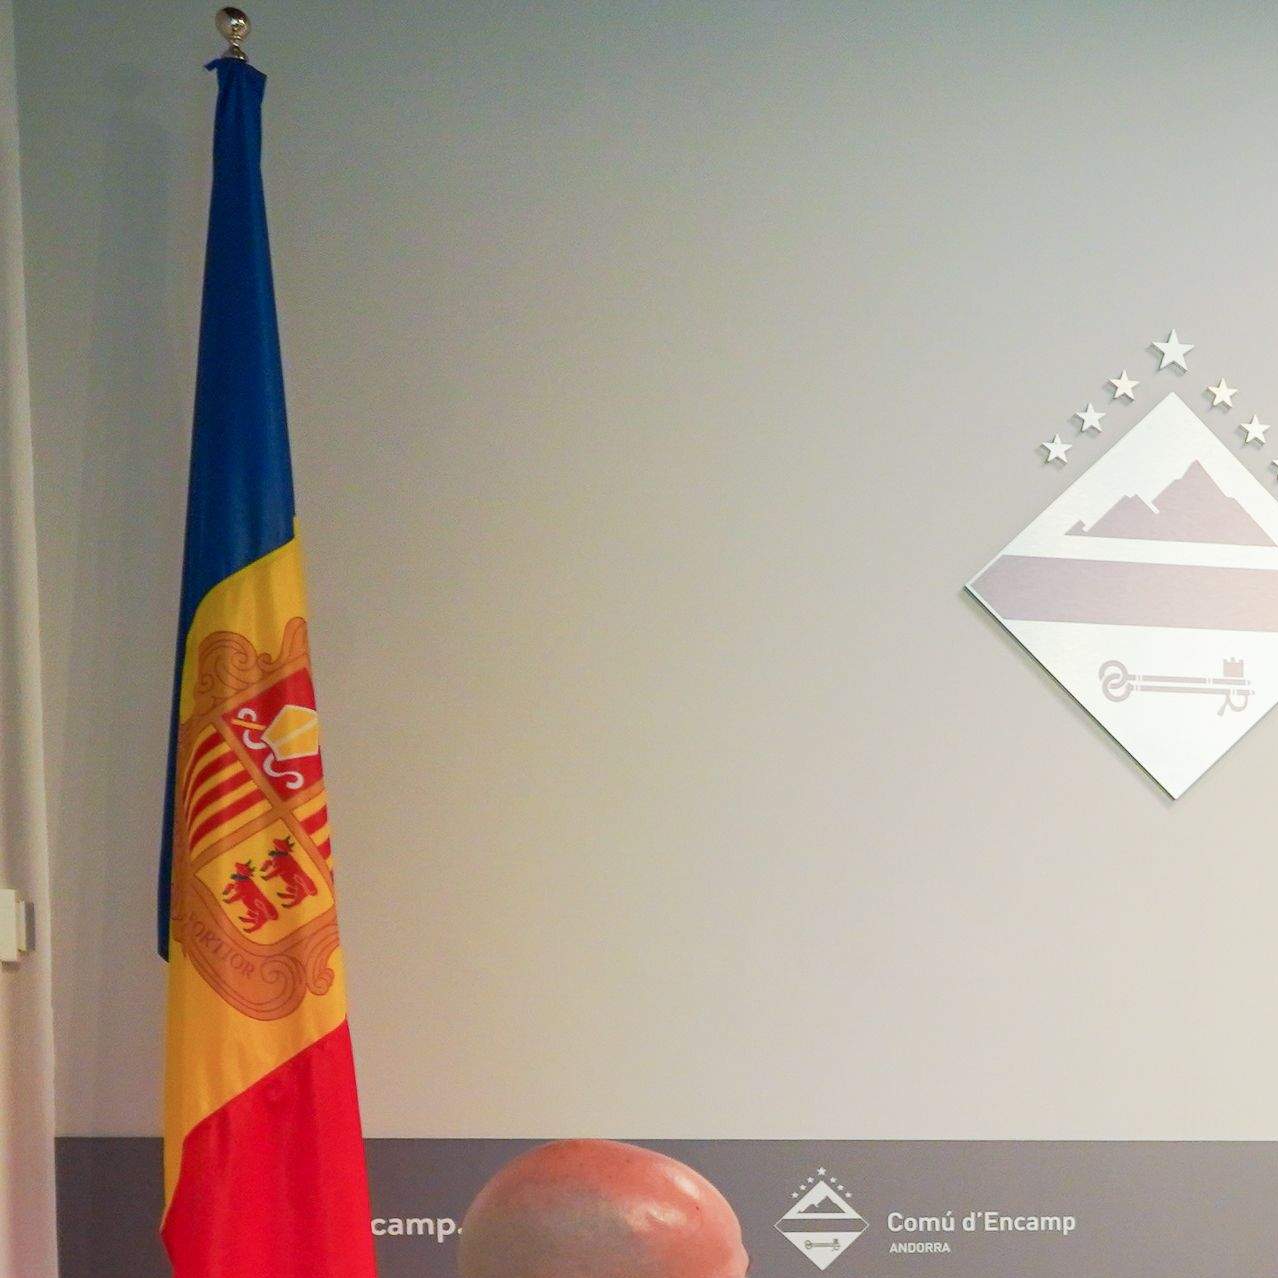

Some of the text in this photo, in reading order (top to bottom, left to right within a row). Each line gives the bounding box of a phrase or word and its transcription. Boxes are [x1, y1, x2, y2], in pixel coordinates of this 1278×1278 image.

[370, 1216, 463, 1244] camp.
[887, 1210, 1077, 1236] Comú d'Encamp
[889, 1242, 951, 1254] ANDORRA
